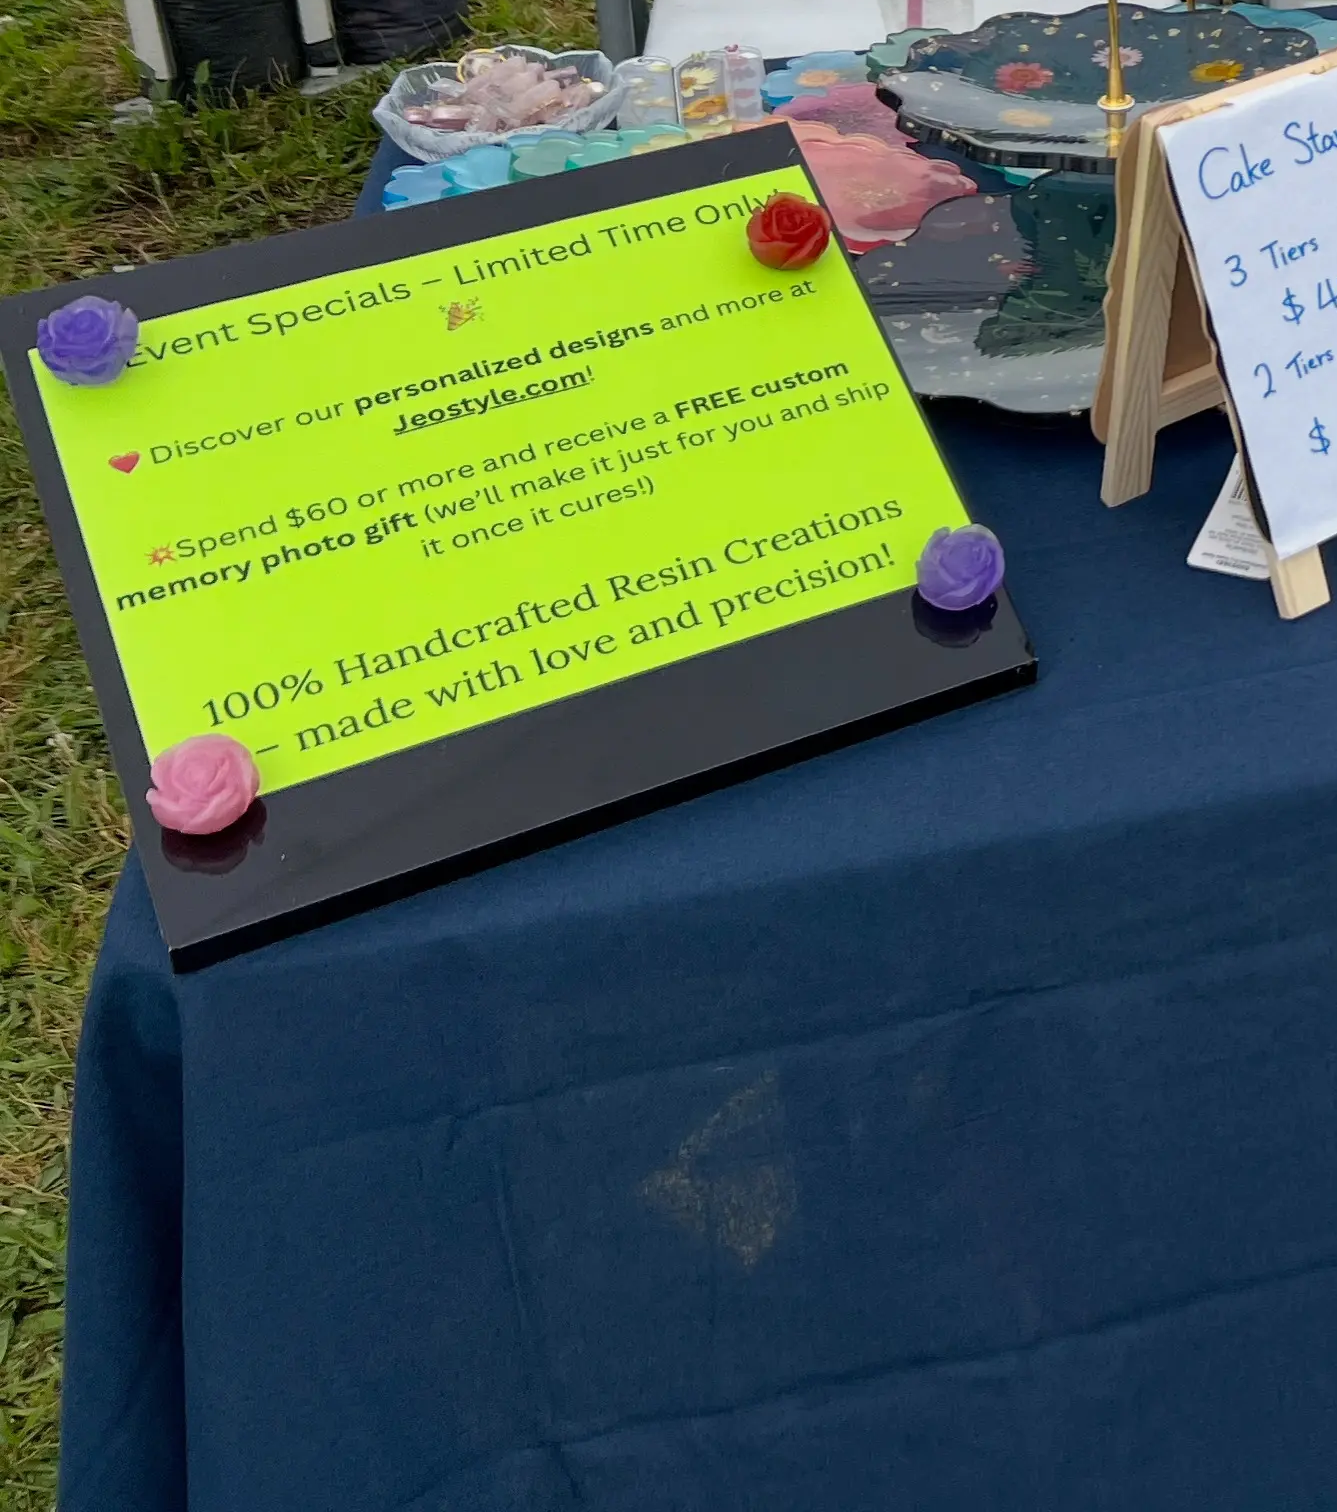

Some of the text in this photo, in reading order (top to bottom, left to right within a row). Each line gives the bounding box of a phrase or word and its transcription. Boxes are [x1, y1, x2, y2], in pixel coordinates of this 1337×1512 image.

[1199, 143, 1275, 199] Cake
[247, 281, 412, 337] Specials
[453, 233, 593, 286] Limited
[598, 214, 688, 249] Time
[1224, 238, 1319, 287] 3 Tiers
[149, 279, 817, 465] Discover our personalized designs and more at
[393, 365, 596, 435] Jeostyle.com!
[1253, 349, 1335, 399] 2 Tiers
[116, 559, 252, 611] memory
[260, 531, 356, 575] photo
[364, 510, 419, 546] gift
[510, 462, 587, 499] make
[590, 454, 615, 477] it
[617, 437, 673, 474] just
[676, 425, 718, 451] for
[722, 412, 775, 443] you
[781, 393, 830, 423] and
[835, 378, 891, 409] ship
[175, 361, 850, 558] Spend $60 or more and receive a FREE custom
[420, 475, 655, 559] it once it cures!)
[202, 498, 903, 728] 100% Handcrafted Resin Creations
[295, 696, 416, 752] made
[424, 660, 525, 708] with
[529, 632, 618, 676] love
[628, 600, 704, 646] and
[709, 541, 897, 628] precision!
